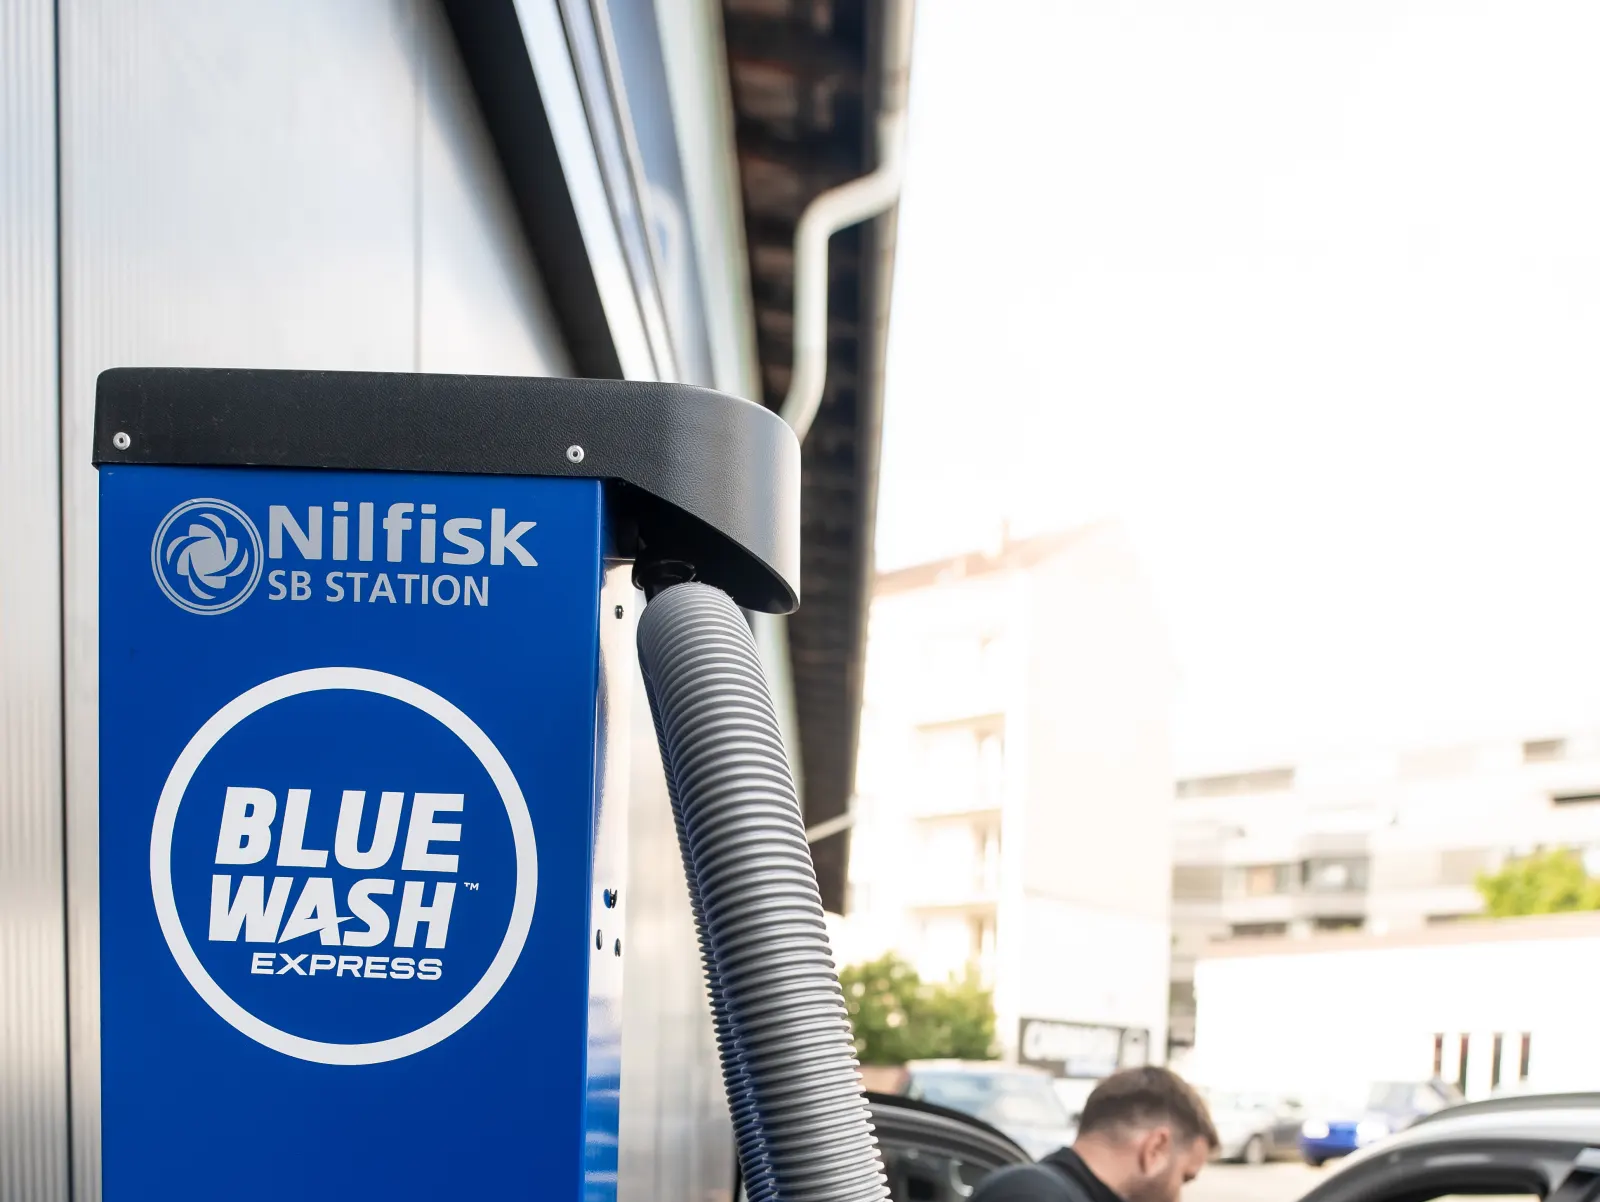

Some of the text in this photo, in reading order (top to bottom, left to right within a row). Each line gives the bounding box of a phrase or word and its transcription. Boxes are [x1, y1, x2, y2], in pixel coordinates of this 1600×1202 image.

[268, 501, 539, 567] Nilfisk
[268, 569, 489, 607] SB STATION
[214, 786, 465, 873] BLUE
[208, 874, 457, 949] WASH
[250, 952, 443, 981] EXPRESS
